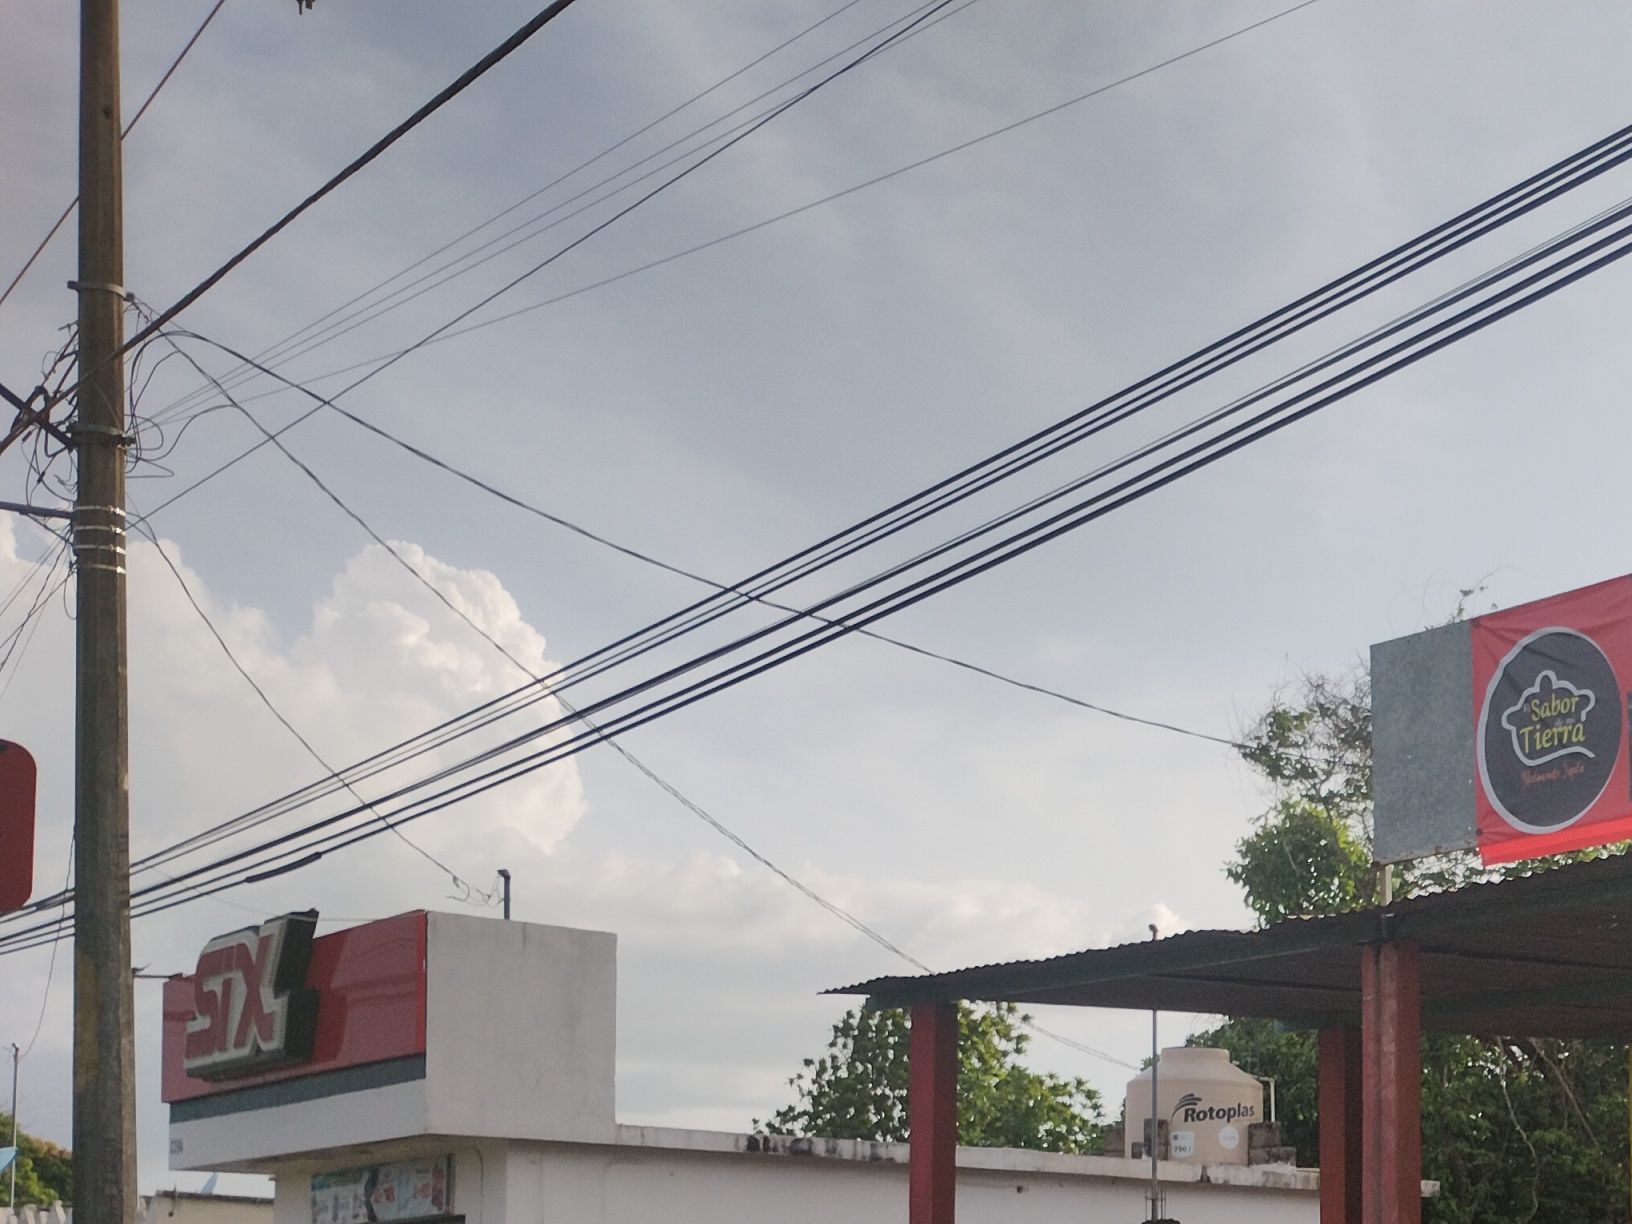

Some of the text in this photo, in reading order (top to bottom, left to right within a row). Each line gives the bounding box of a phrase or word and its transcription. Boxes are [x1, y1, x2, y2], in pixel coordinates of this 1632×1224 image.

[1531, 693, 1579, 721] Sabor
[1519, 723, 1586, 753] Tierra
[1183, 1103, 1255, 1124] Rotoplas
